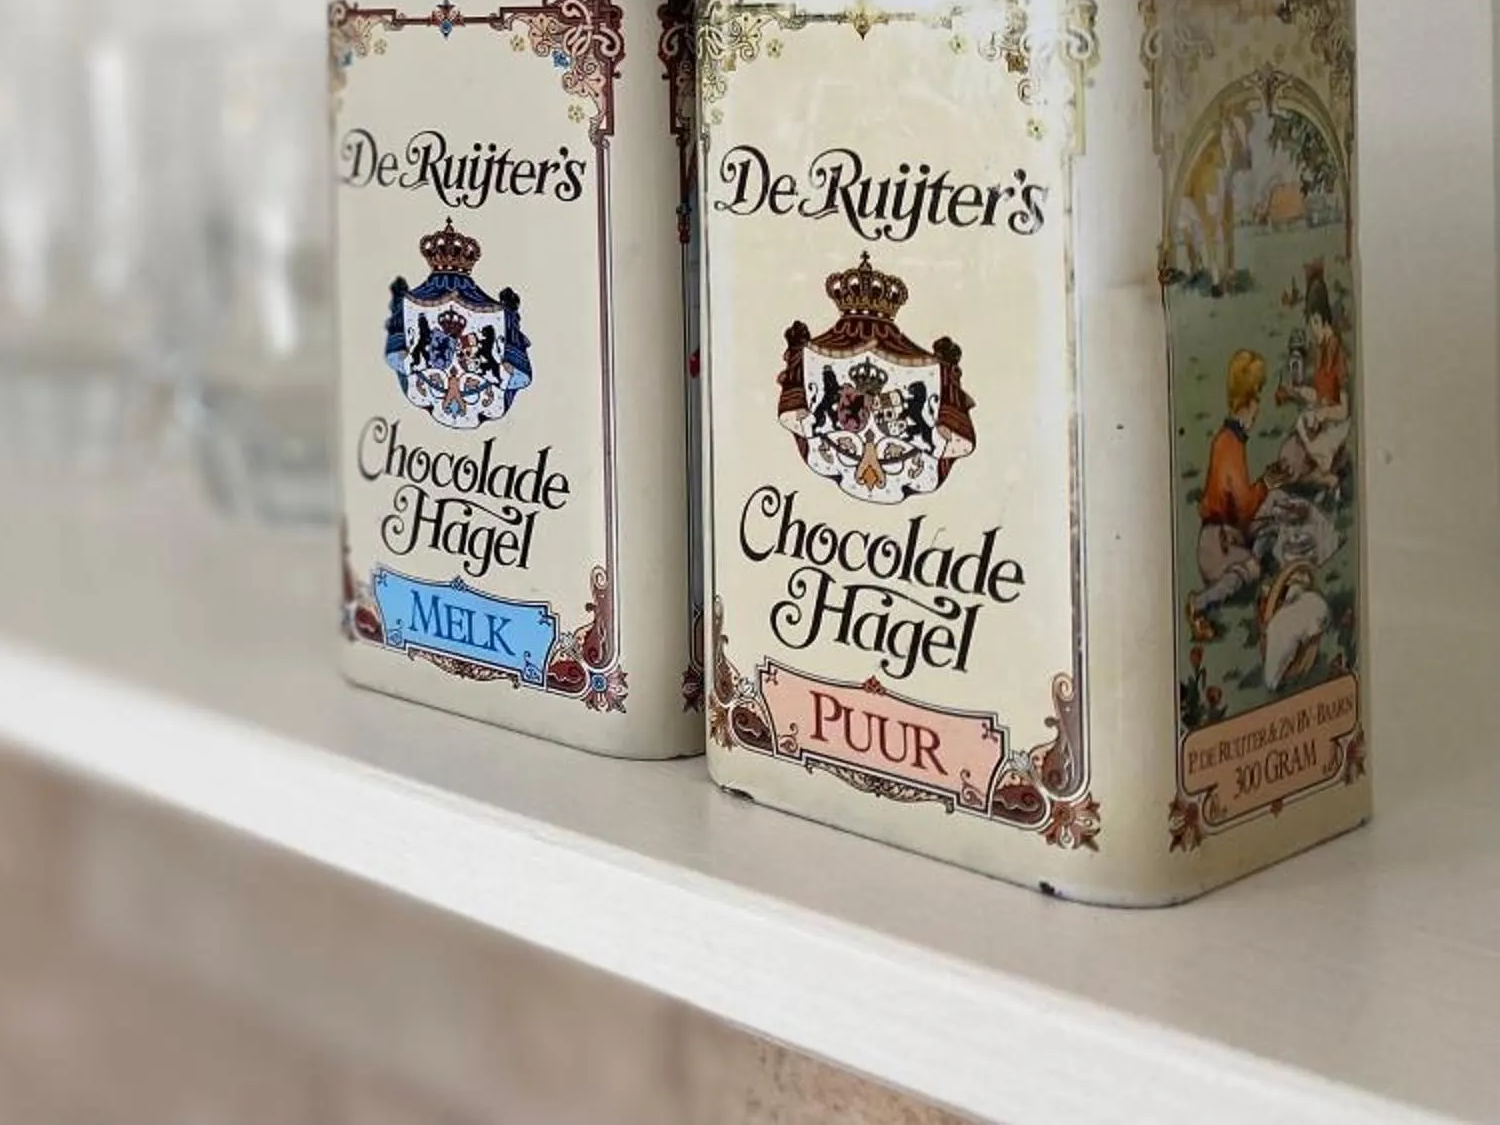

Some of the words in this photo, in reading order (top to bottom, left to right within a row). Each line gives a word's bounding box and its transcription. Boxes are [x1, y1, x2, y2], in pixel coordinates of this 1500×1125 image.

[341, 128, 398, 188] De
[399, 130, 587, 209] Ruijter's
[714, 144, 798, 215] De
[798, 147, 1049, 241] Ruijter's
[358, 416, 570, 510] Chocolade
[381, 484, 539, 578] Hagel
[739, 485, 1025, 603] Chocolade
[409, 589, 517, 657] MELK
[770, 566, 983, 680] Hagel
[809, 690, 948, 775] PUUR
[1233, 764, 1261, 800] 300
[1264, 738, 1317, 784] GRAM
